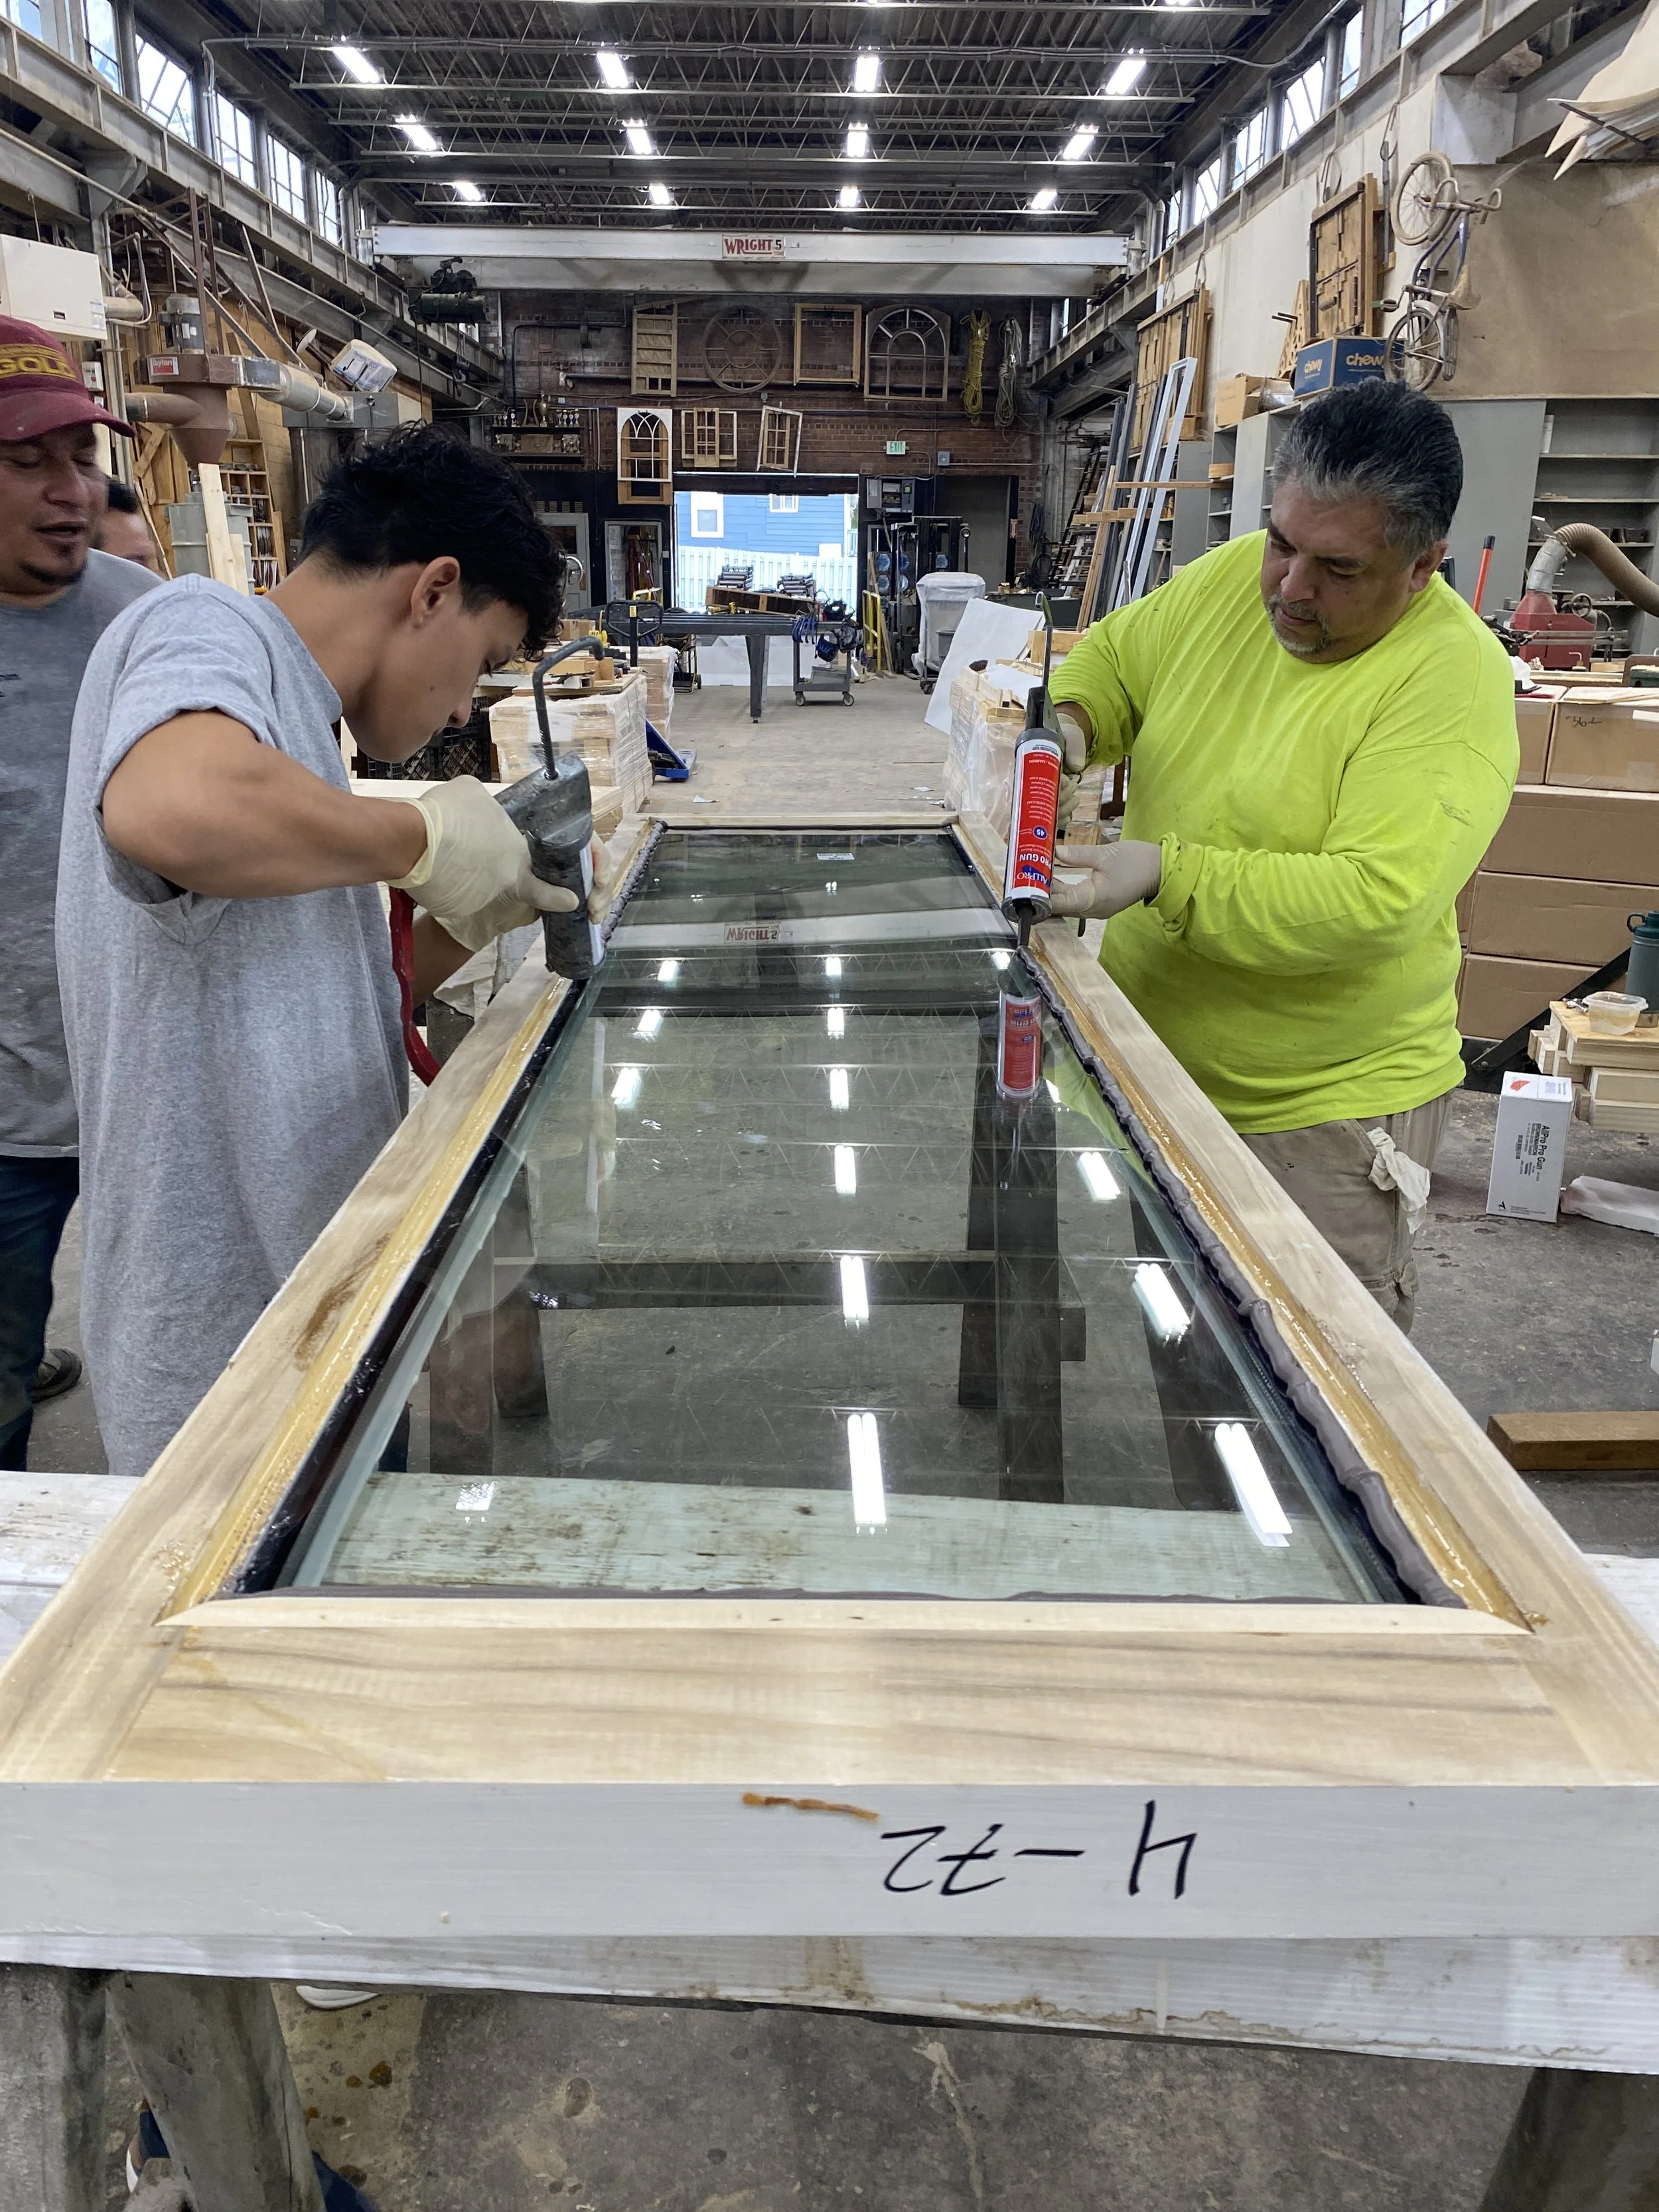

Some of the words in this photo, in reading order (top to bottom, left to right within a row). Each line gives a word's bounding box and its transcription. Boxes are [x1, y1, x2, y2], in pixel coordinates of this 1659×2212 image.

[724, 239, 773, 254] WRIGHT
[775, 239, 782, 250] 5
[1304, 358, 1323, 373] chewy
[1346, 352, 1384, 366] chew
[890, 441, 903, 453] EXIT
[1019, 853, 1039, 862] GUN
[1040, 856, 1052, 870] PRO
[1017, 871, 1048, 885] ALLPRO
[1540, 1125, 1550, 1143] AllPro
[1538, 1144, 1548, 1156] Pro
[1536, 1157, 1546, 1170] Gun
